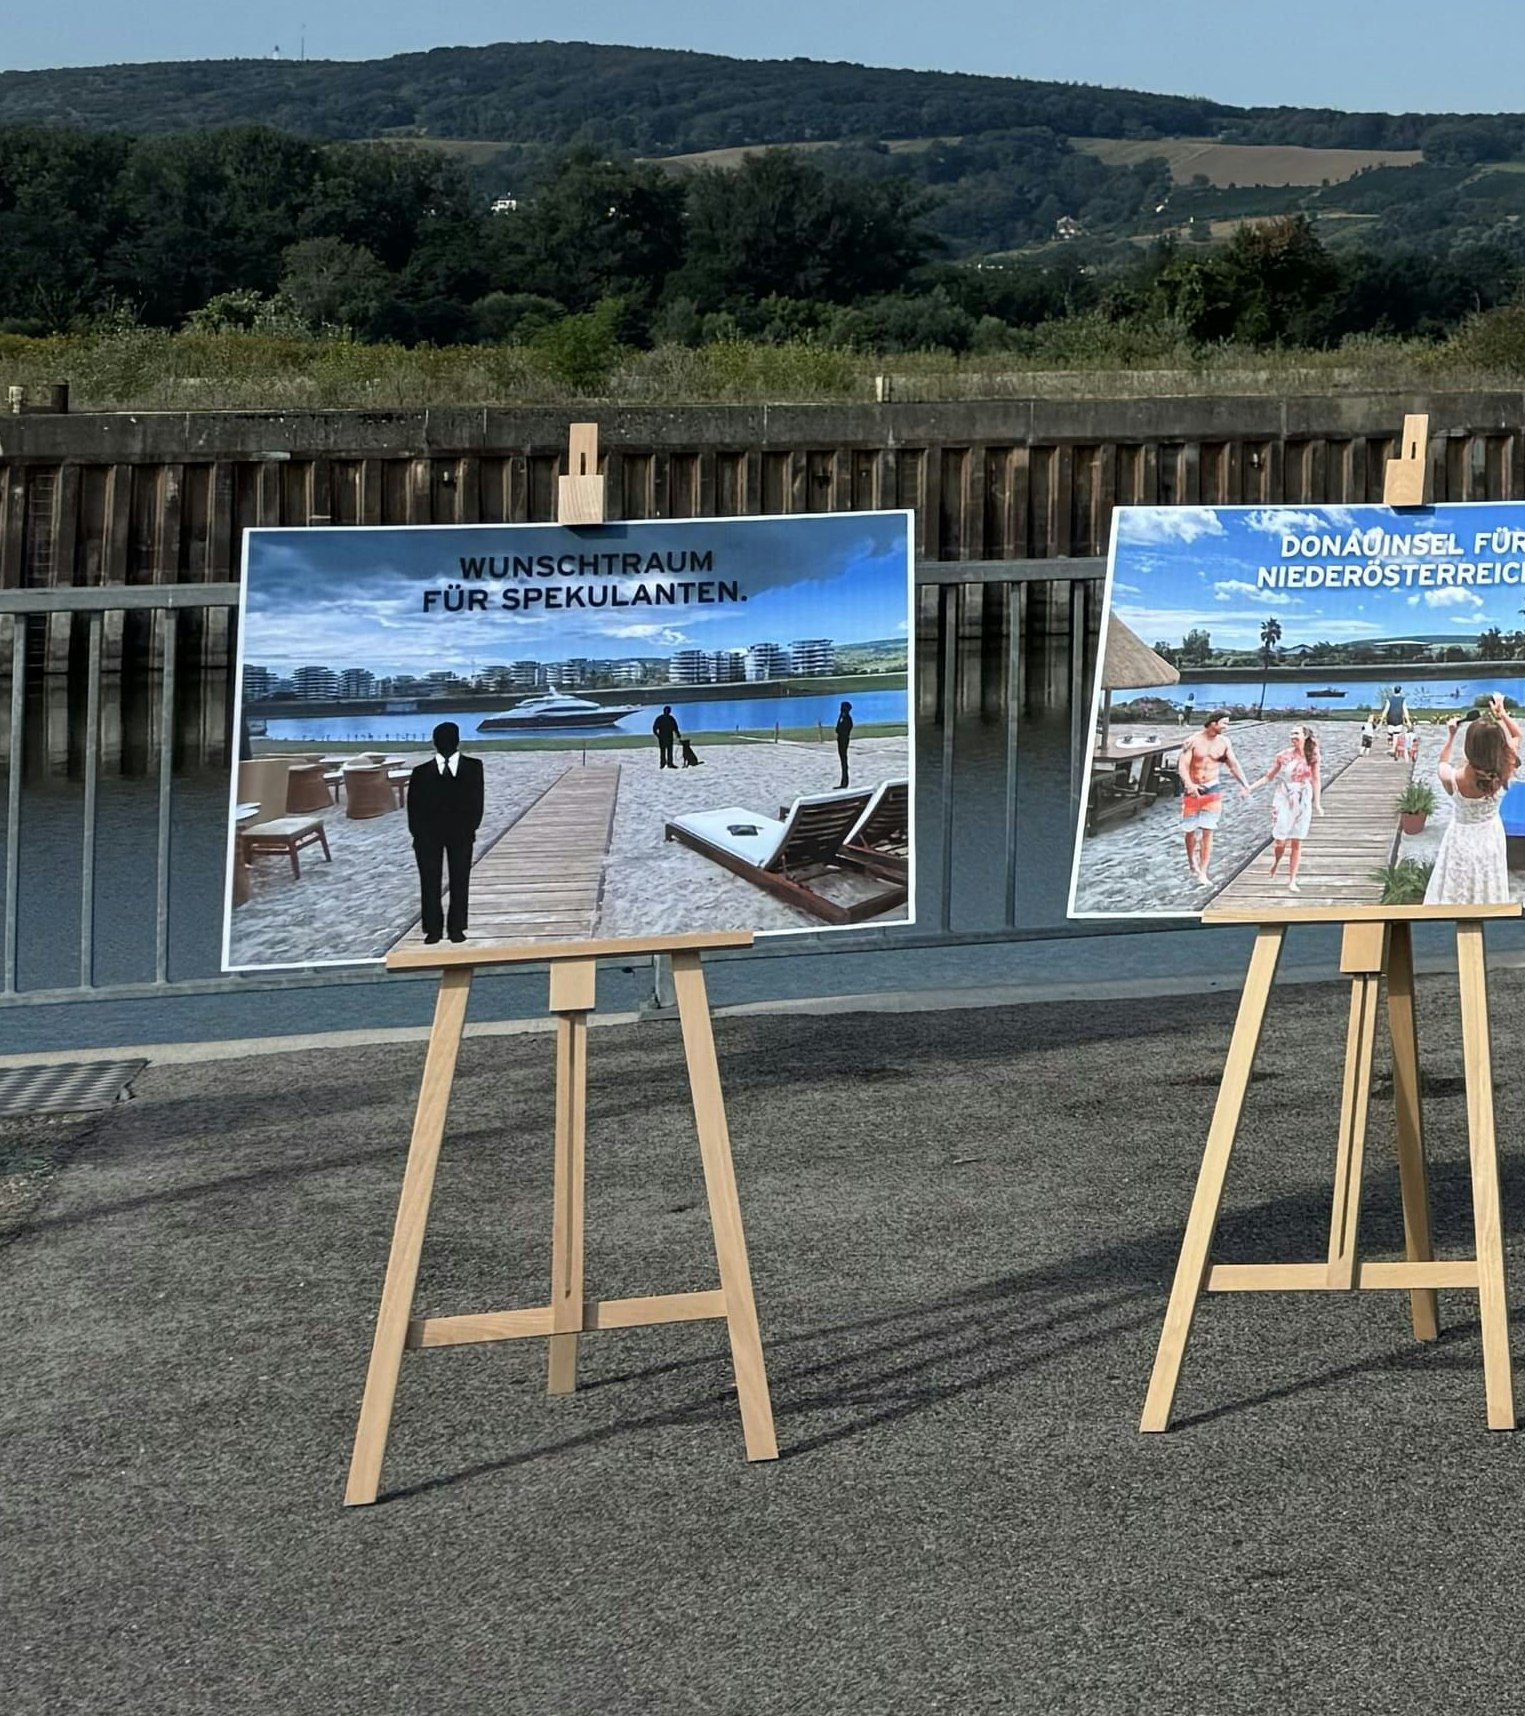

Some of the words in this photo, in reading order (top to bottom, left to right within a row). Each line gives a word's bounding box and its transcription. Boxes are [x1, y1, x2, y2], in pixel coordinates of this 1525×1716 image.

[1281, 532, 1465, 558] DONAUINSEL
[460, 550, 713, 580] WUNSCHTRAUM
[423, 584, 488, 613] FÜR
[502, 580, 748, 610] SPEKULANTEN.
